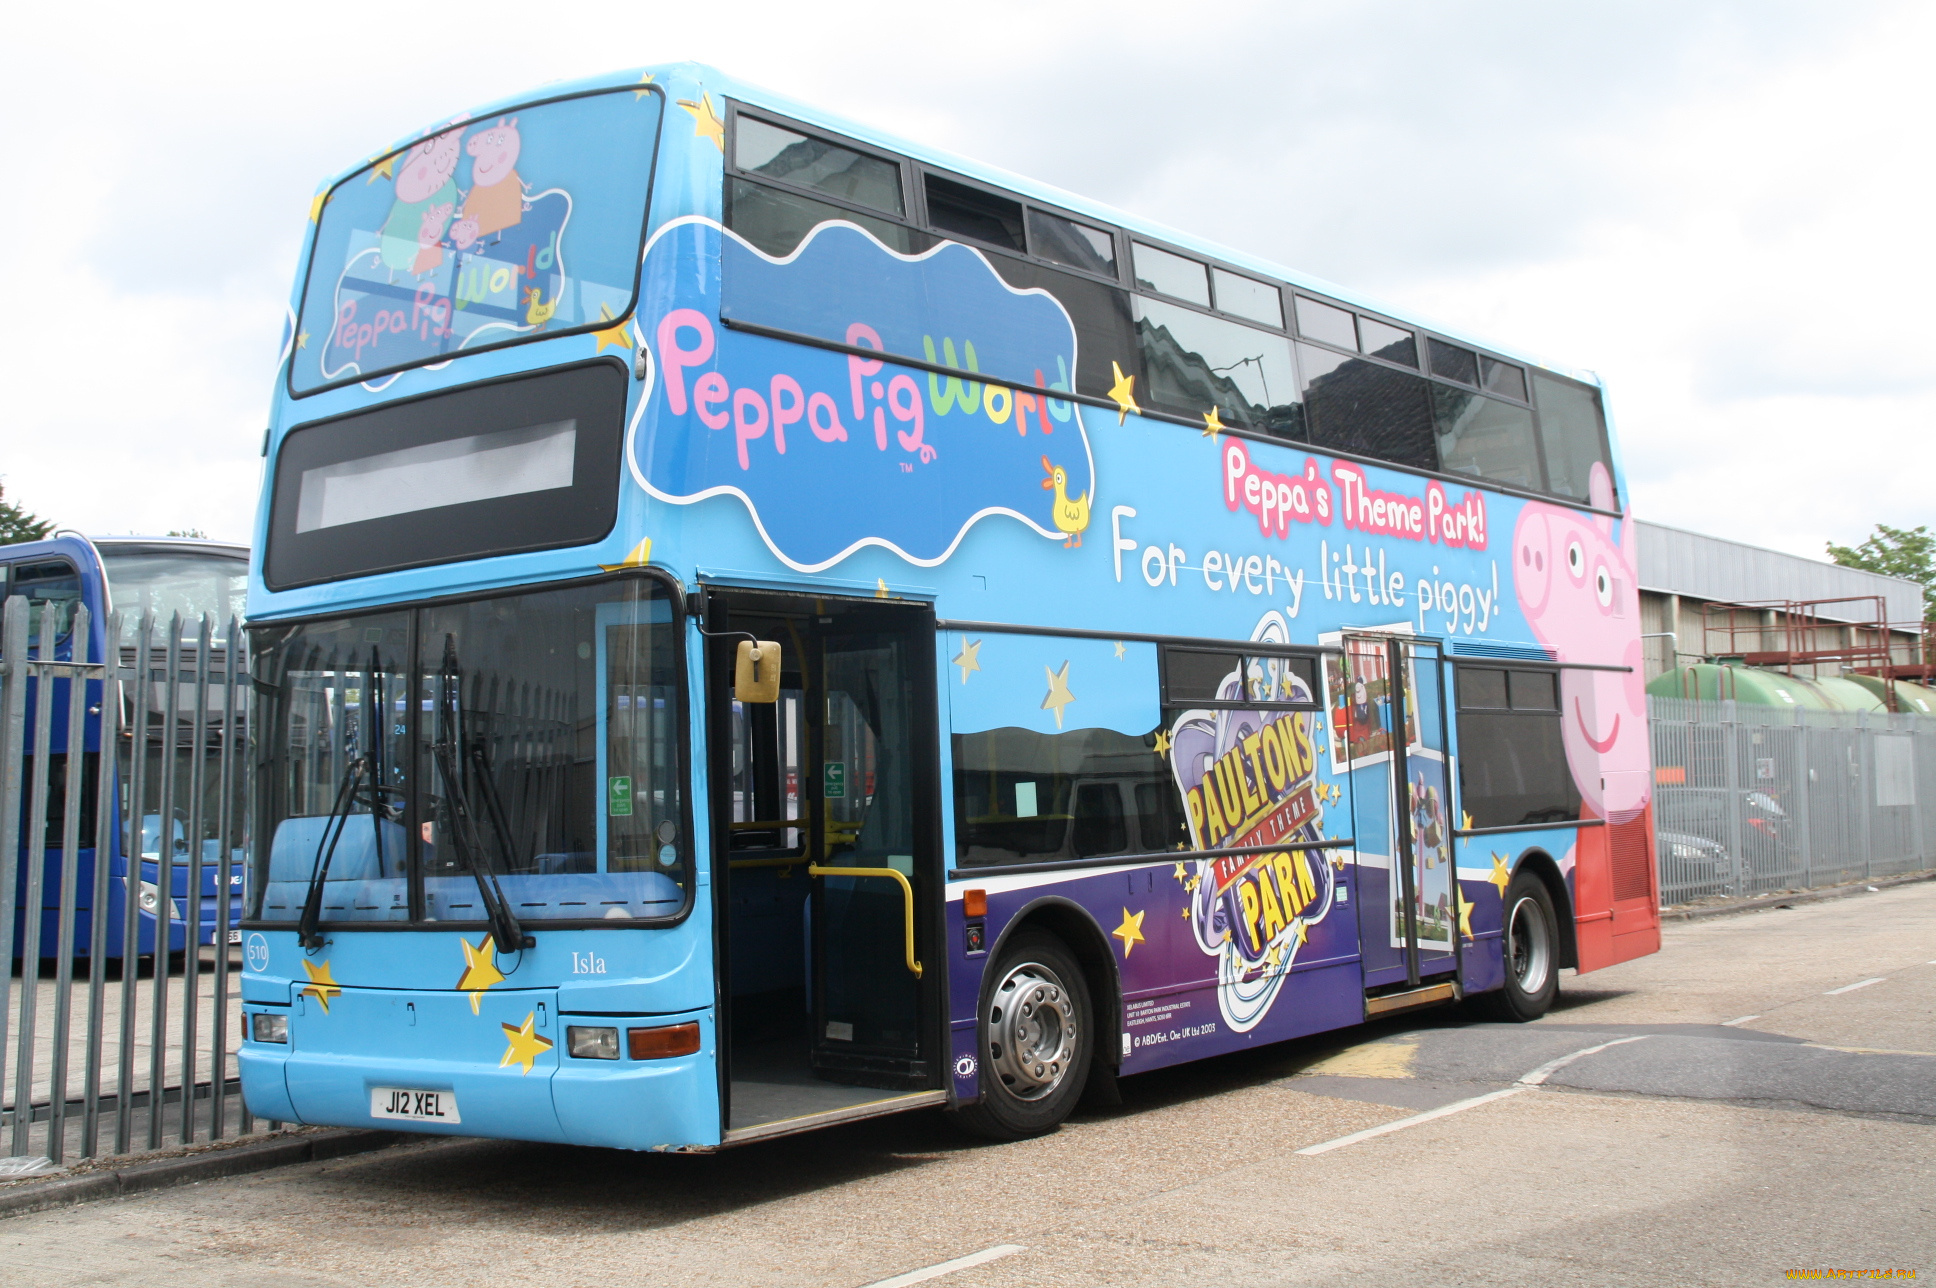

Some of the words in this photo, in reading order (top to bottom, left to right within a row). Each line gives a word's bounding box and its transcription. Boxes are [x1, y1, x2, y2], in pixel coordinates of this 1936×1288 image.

[335, 299, 408, 360] Peppa
[412, 281, 454, 341] Pig
[455, 230, 556, 311] World
[657, 308, 848, 471] Peppa
[846, 322, 937, 464] Pig
[923, 334, 1072, 437] World
[1226, 445, 1329, 531] Peppa's
[1335, 468, 1422, 534] Theme
[1428, 488, 1485, 544] Park!
[1111, 504, 1186, 588] For
[1202, 549, 1304, 619] every
[1320, 539, 1404, 607] little
[1417, 559, 1499, 636] piggy!
[1187, 711, 1314, 850] PAULTONS
[1269, 796, 1306, 838] THEME
[1240, 836, 1317, 953] PARK
[249, 945, 267, 959] 510
[572, 951, 607, 974] Isla
[1169, 1030, 1181, 1041] One
[1182, 1027, 1190, 1038] UK
[1191, 1026, 1200, 1036] Ltd
[1201, 1023, 1216, 1035] 2003
[385, 1091, 410, 1114] J12
[414, 1092, 445, 1117] XEL
